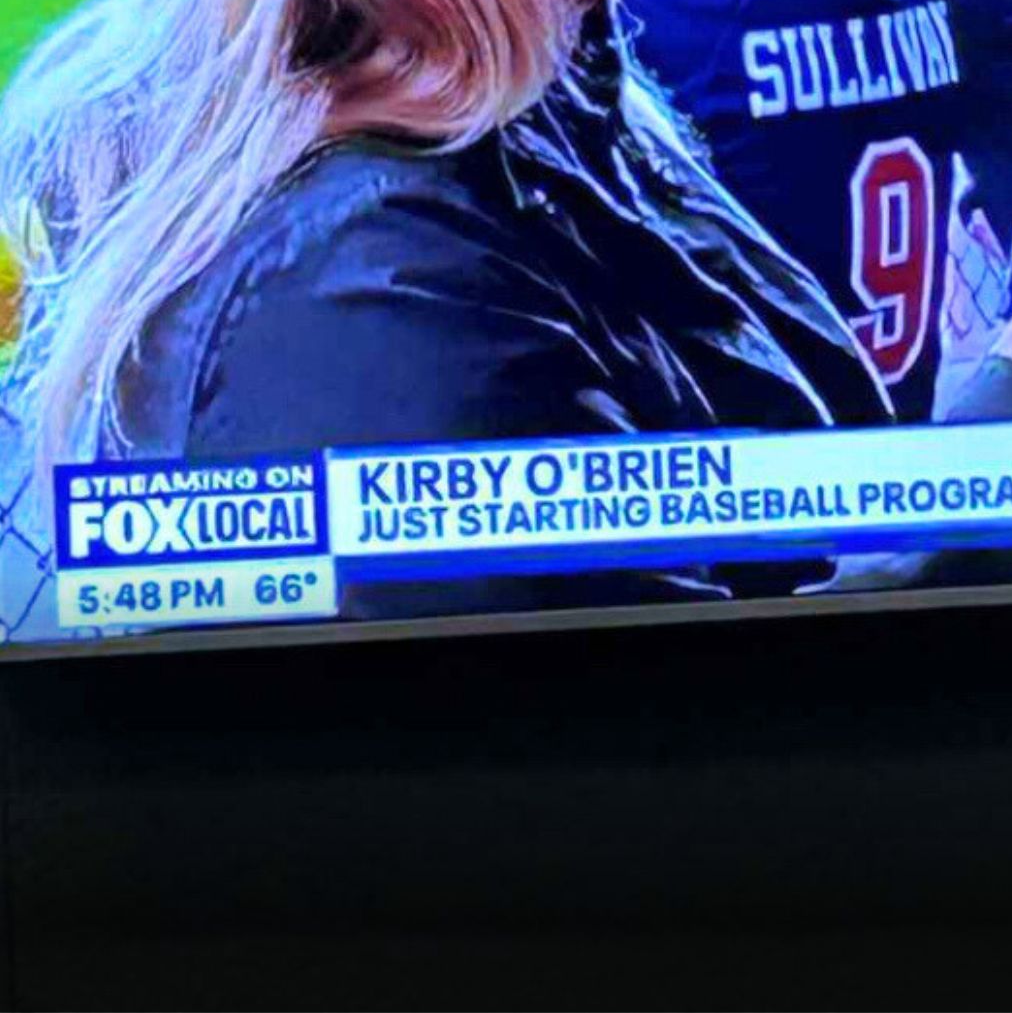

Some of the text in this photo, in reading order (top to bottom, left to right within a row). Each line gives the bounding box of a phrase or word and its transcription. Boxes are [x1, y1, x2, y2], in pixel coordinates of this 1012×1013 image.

[847, 136, 936, 386] 9
[265, 464, 314, 489] ON
[358, 445, 733, 506] KIRBY O'BRIEN
[68, 494, 312, 558] FOX LOCAL
[358, 505, 450, 543] JUST
[457, 495, 652, 536] STARTING
[660, 484, 851, 527] BASEBALL
[77, 571, 318, 615] 5:48 PM 66°
